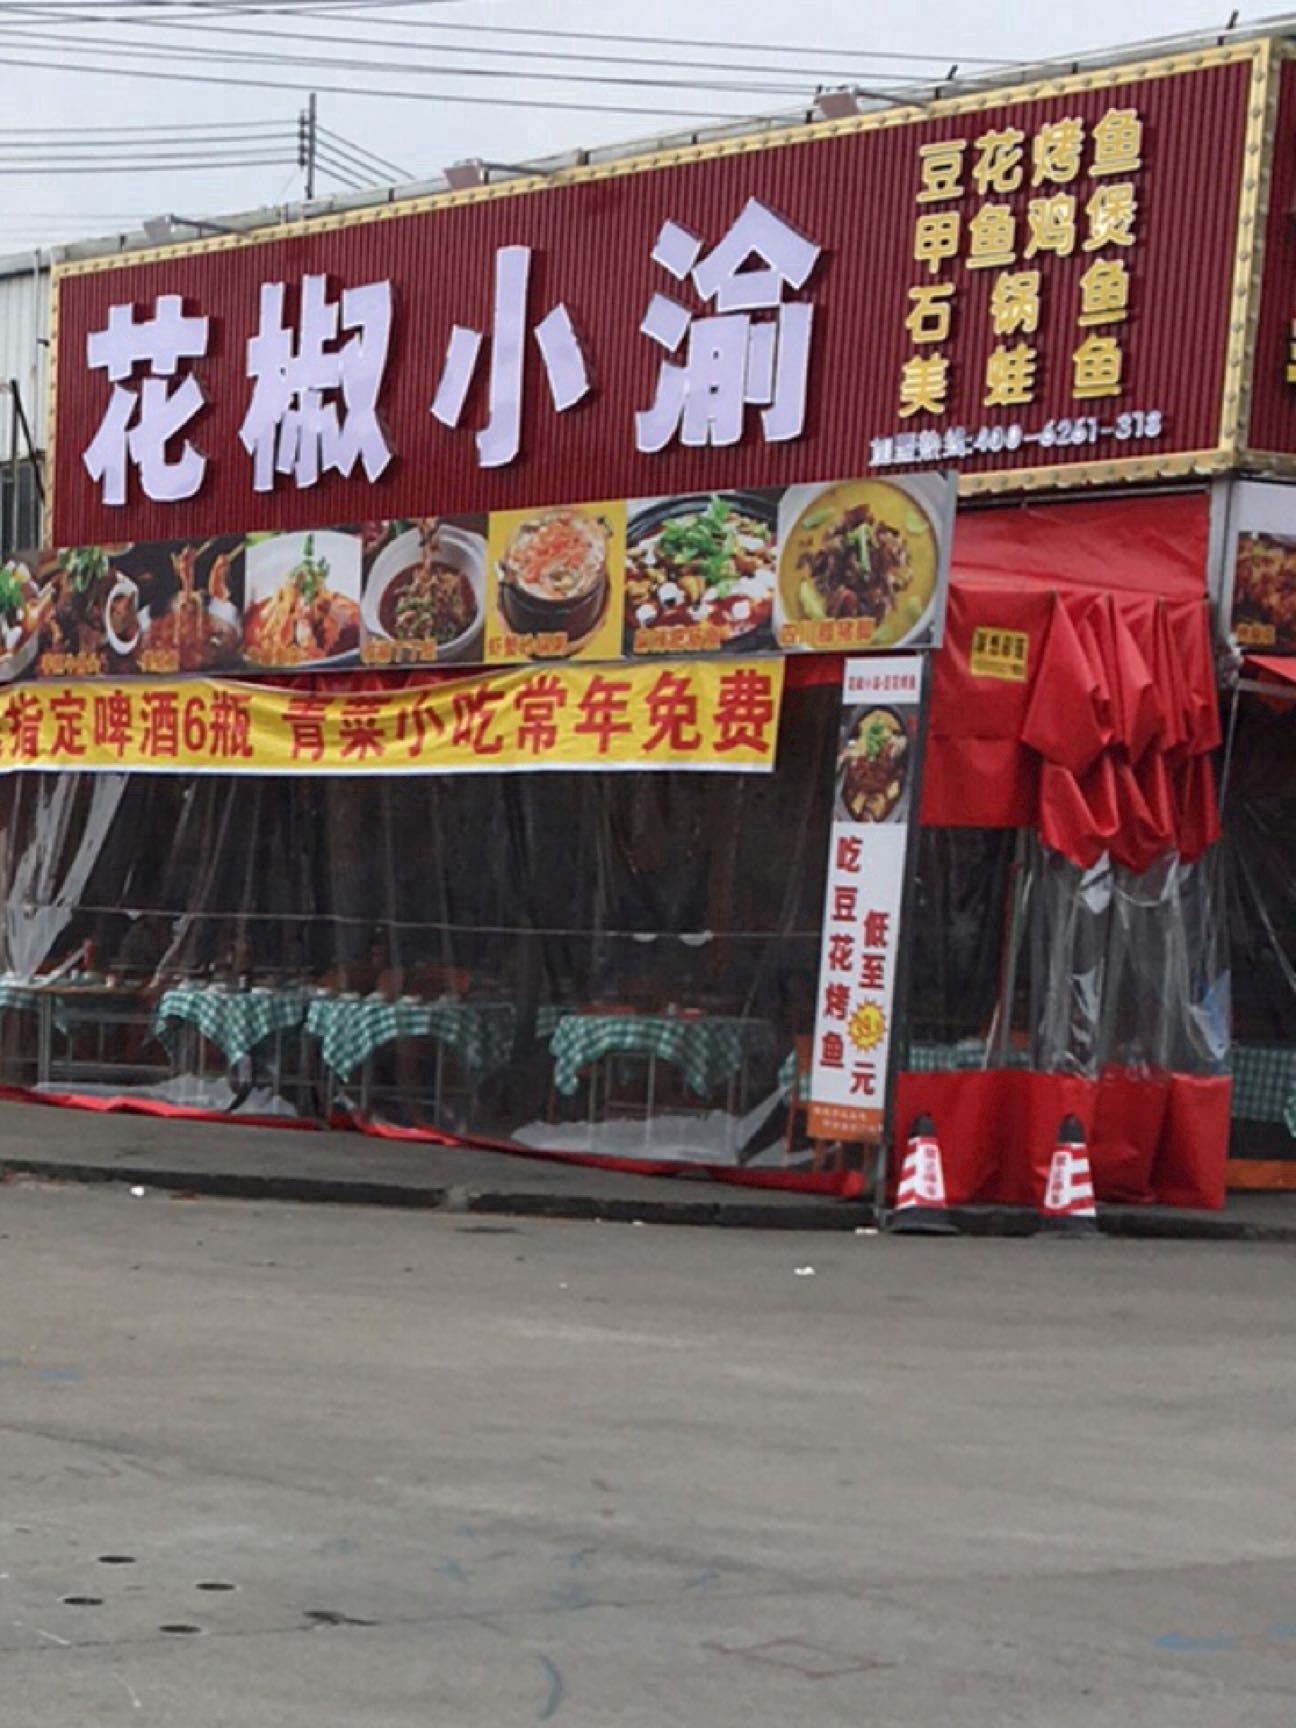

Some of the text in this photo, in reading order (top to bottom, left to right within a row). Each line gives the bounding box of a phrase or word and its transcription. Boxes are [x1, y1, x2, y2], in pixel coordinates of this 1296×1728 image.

[915, 107, 1142, 203] 豆花烤鱼
[913, 181, 1136, 274] 甲鱼鸡煲
[906, 258, 1130, 345] 石锅鱼
[83, 196, 822, 506] 花椒小渝
[898, 335, 1122, 419] 美蛙鱼
[282, 667, 772, 762] 青菜小吃常年免费
[819, 835, 864, 1069] 吃豆花烤鱼
